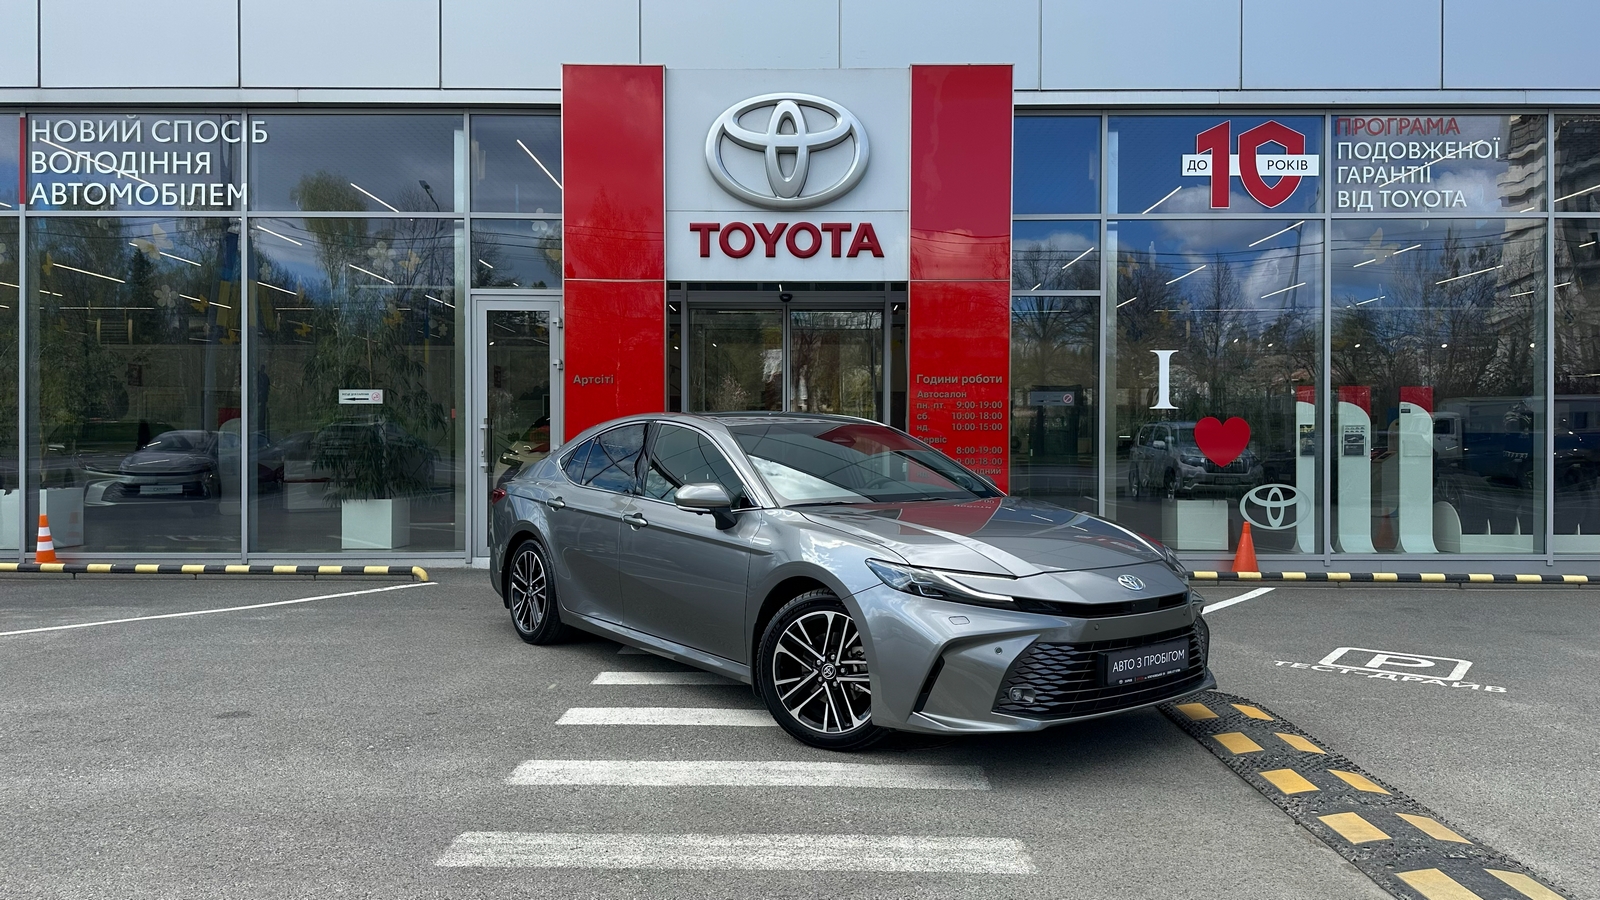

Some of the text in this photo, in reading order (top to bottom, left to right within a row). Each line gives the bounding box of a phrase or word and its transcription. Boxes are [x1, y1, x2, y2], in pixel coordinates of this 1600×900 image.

[31, 115, 268, 145] НОВИЙ СПОСІБ
[1336, 117, 1460, 137] ПРОГРАМА
[1337, 137, 1501, 163] ПОДОВЖЕНОЇ
[31, 151, 212, 179] ВОЛОДІННЯ
[1186, 158, 1208, 173] ДО
[1266, 158, 1309, 172] РОКІВ
[1337, 164, 1432, 185] ГАРАНТІЇ
[29, 182, 248, 207] АВТОМОБІЛЕМ
[1337, 190, 1468, 211] ВІД TOYOTA
[689, 221, 885, 259] TOYOTA
[573, 374, 614, 387] Артсіті
[916, 373, 1003, 386] Години роботи
[917, 390, 967, 399] Автосалон
[916, 411, 1003, 421] сб. 10:00-18:00
[951, 422, 1003, 431] 10:00-15:00
[1112, 658, 1135, 673] АВТО
[1143, 649, 1185, 668] ПРОБІГОМ
[1273, 660, 1508, 693] ТЕСТ-ДРАЙВ
